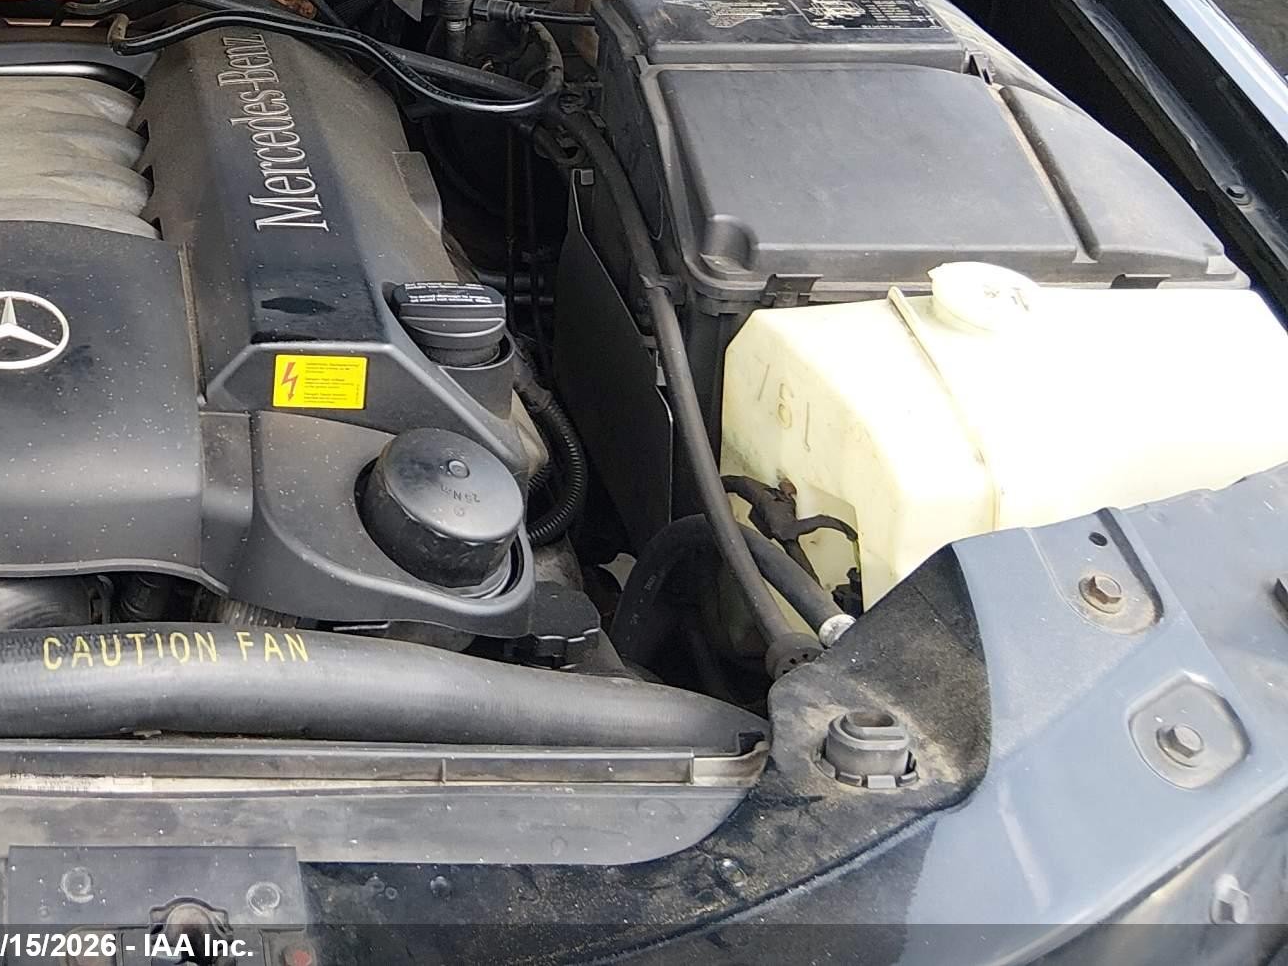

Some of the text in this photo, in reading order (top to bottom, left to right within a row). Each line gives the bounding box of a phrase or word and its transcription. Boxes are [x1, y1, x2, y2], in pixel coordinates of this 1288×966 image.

[216, 33, 330, 232] Mercedes-Benz
[42, 631, 309, 670] CAUTION FAN
